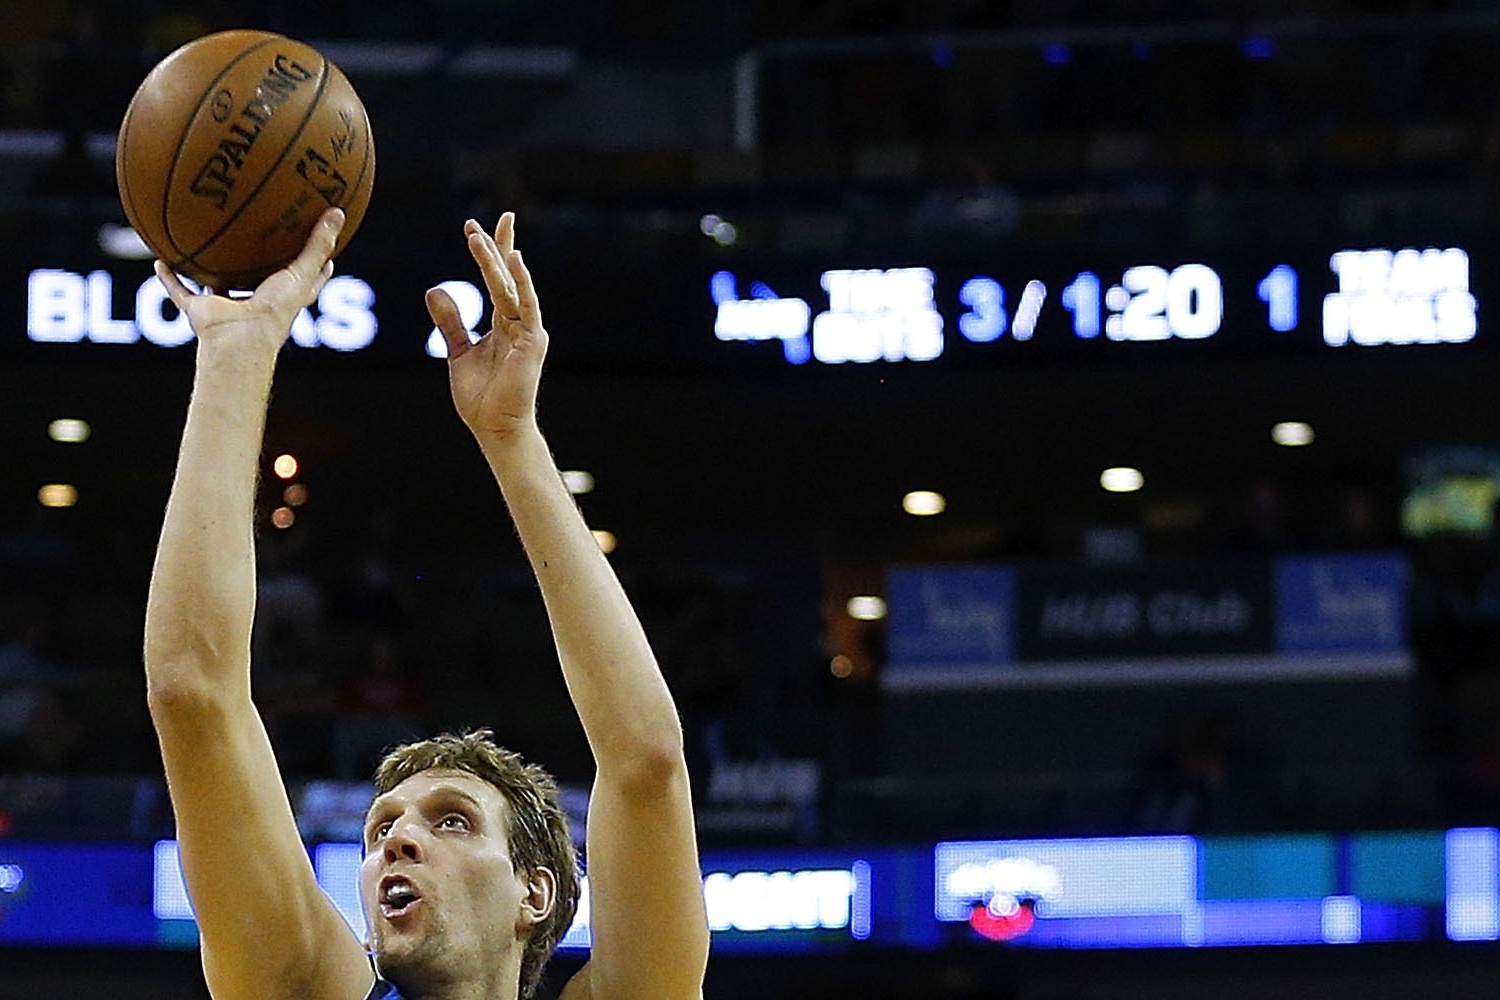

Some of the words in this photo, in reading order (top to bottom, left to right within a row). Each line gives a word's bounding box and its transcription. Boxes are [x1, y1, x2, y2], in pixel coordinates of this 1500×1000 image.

[190, 54, 313, 210] SPALDING
[27, 269, 379, 352] BLOS
[1257, 264, 1299, 332] 1
